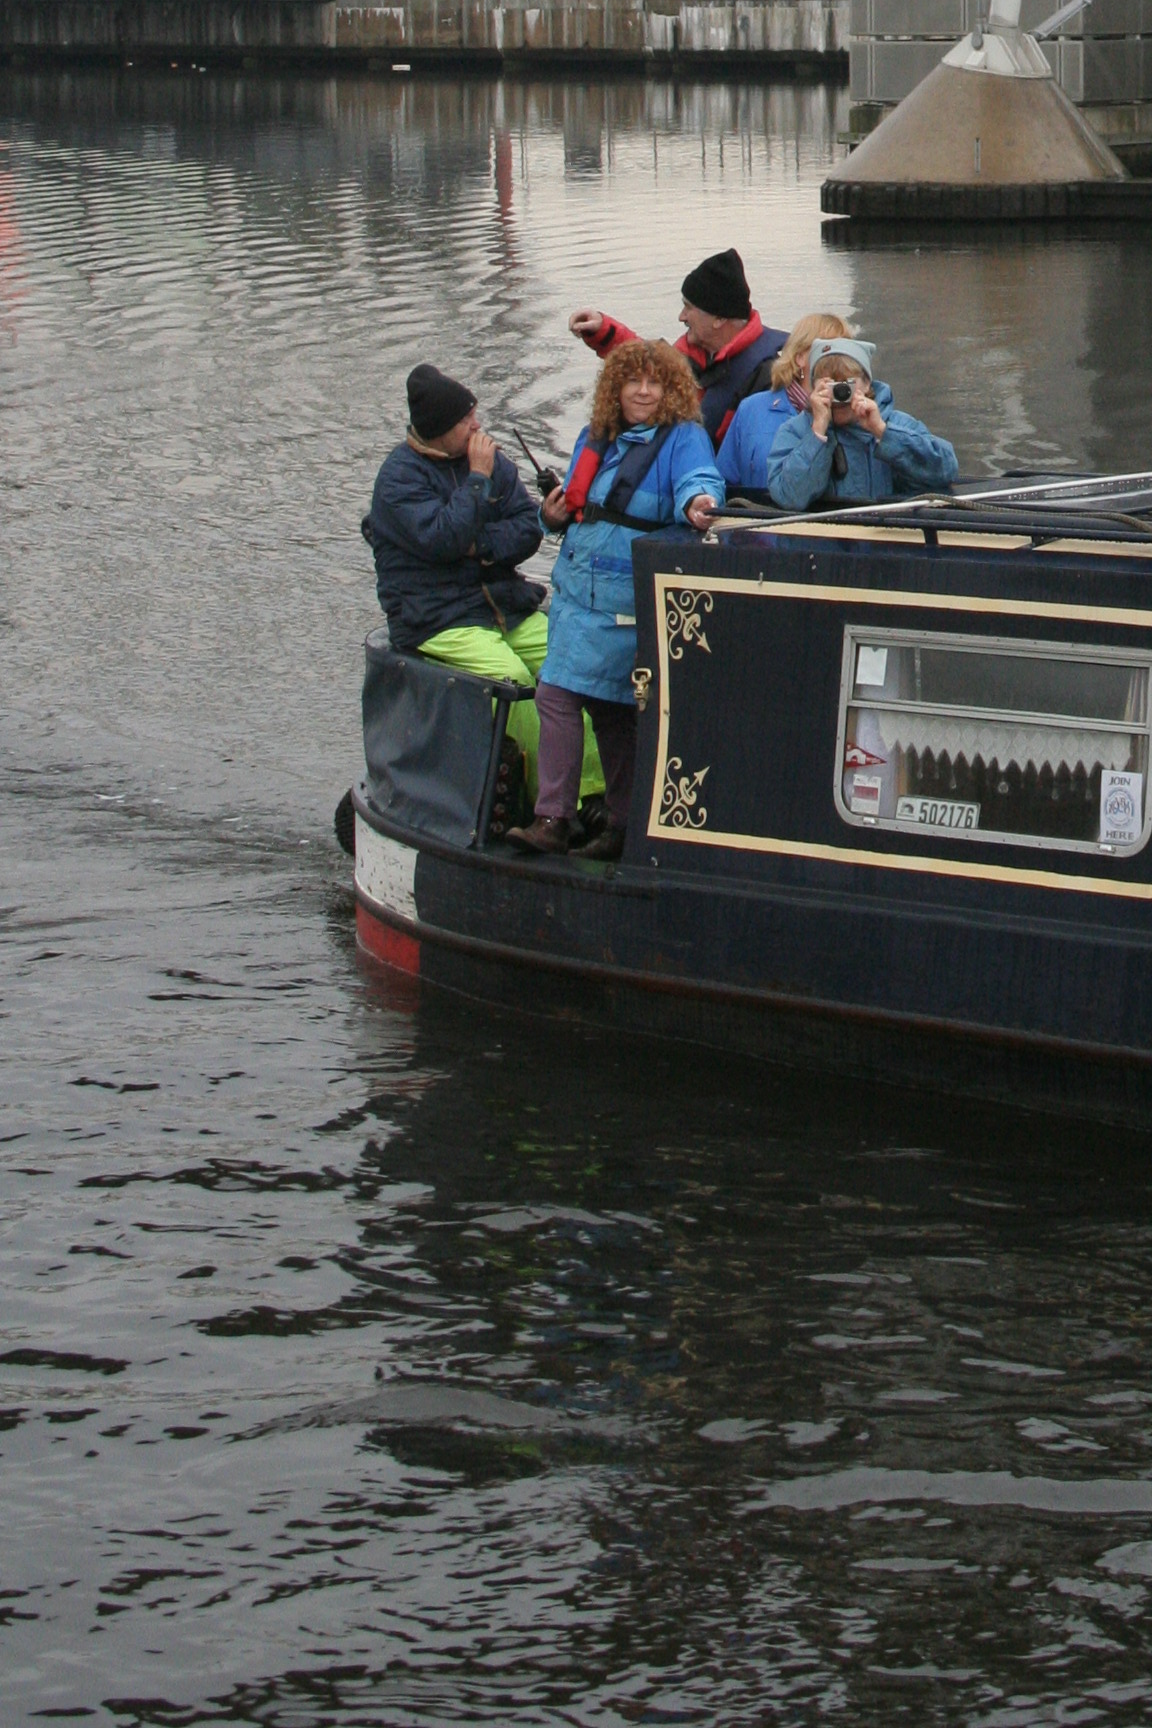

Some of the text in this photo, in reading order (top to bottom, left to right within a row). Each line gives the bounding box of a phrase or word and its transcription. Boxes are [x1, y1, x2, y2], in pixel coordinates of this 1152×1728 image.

[1108, 776, 1131, 786] JOIN
[918, 801, 975, 828] 502176
[1105, 831, 1135, 840] HERE
